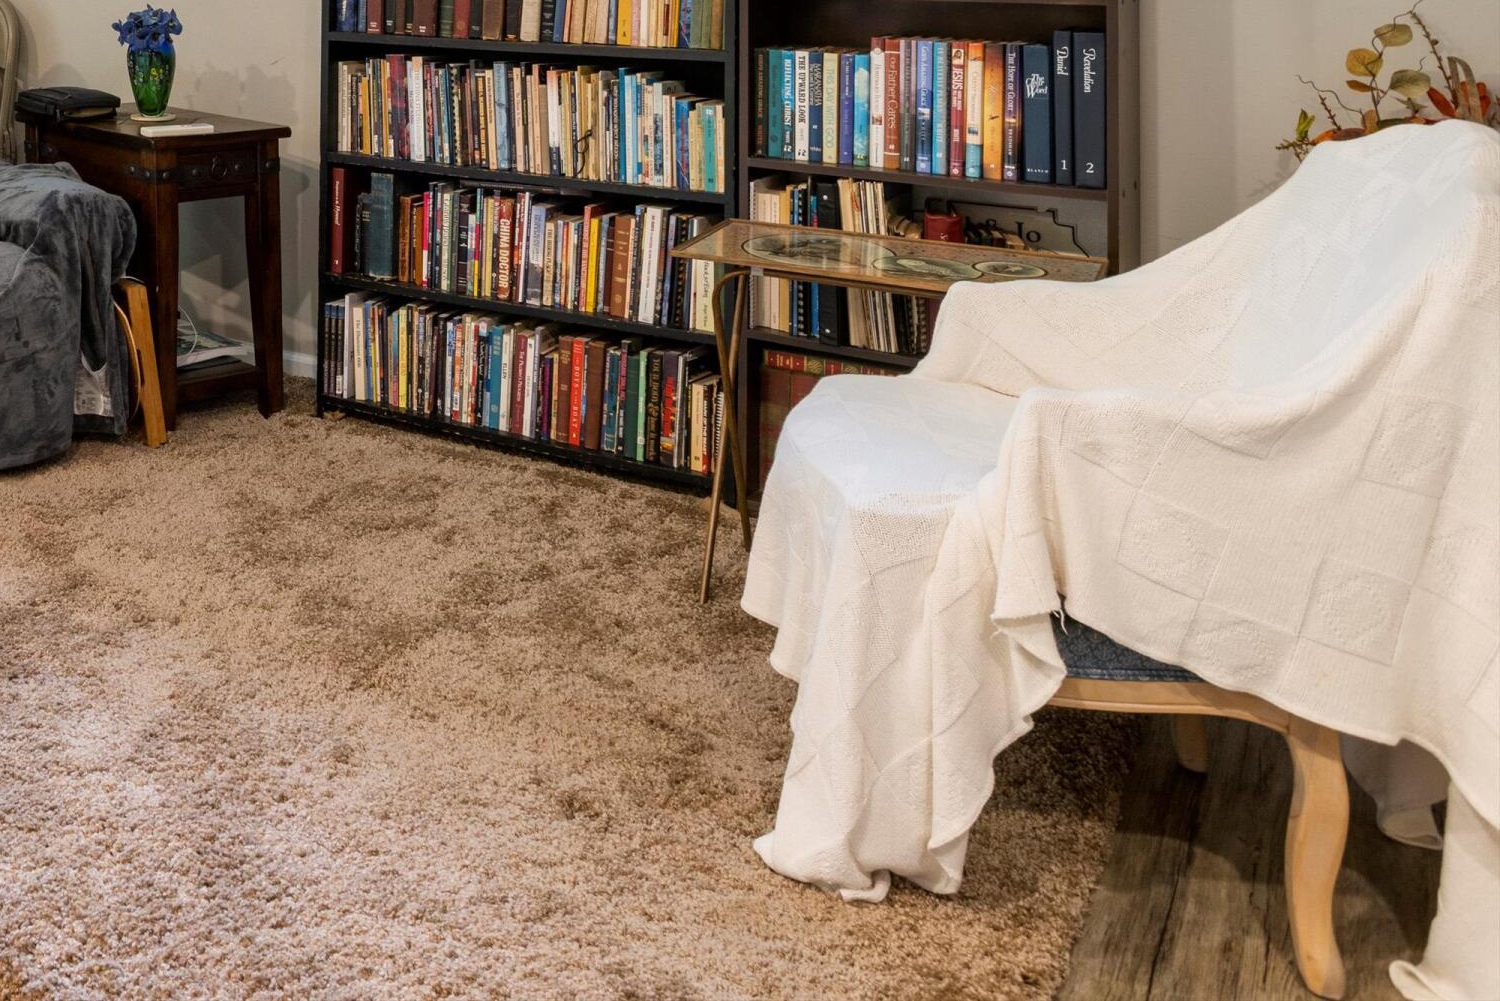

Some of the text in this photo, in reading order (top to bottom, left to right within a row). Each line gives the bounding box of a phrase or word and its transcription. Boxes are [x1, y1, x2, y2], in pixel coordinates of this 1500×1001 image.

[798, 56, 806, 70] THE
[1007, 53, 1016, 64] THE
[1056, 46, 1069, 76] Daniel
[784, 59, 792, 99] REFLECTING
[952, 67, 964, 90] JESUS
[1007, 66, 1016, 82] HOPE
[1082, 48, 1096, 93] Revelation
[798, 73, 806, 103] UPWARD
[814, 64, 822, 106] MARANATHA
[888, 70, 898, 98] Father
[1026, 86, 1048, 98] Word
[825, 69, 834, 148] THIS DAY WITH GOD
[1007, 91, 1016, 112] GLORY
[784, 101, 792, 126] CHRIST
[798, 105, 806, 123] LOOK
[888, 99, 898, 129] Cares
[1061, 160, 1067, 170] 1
[1086, 162, 1094, 173] 2
[333, 205, 341, 226] Hymnal
[498, 218, 511, 287] CHINA DOCTOR
[652, 359, 661, 380] YOUR
[651, 382, 660, 402] BODY
[649, 440, 657, 461] works
